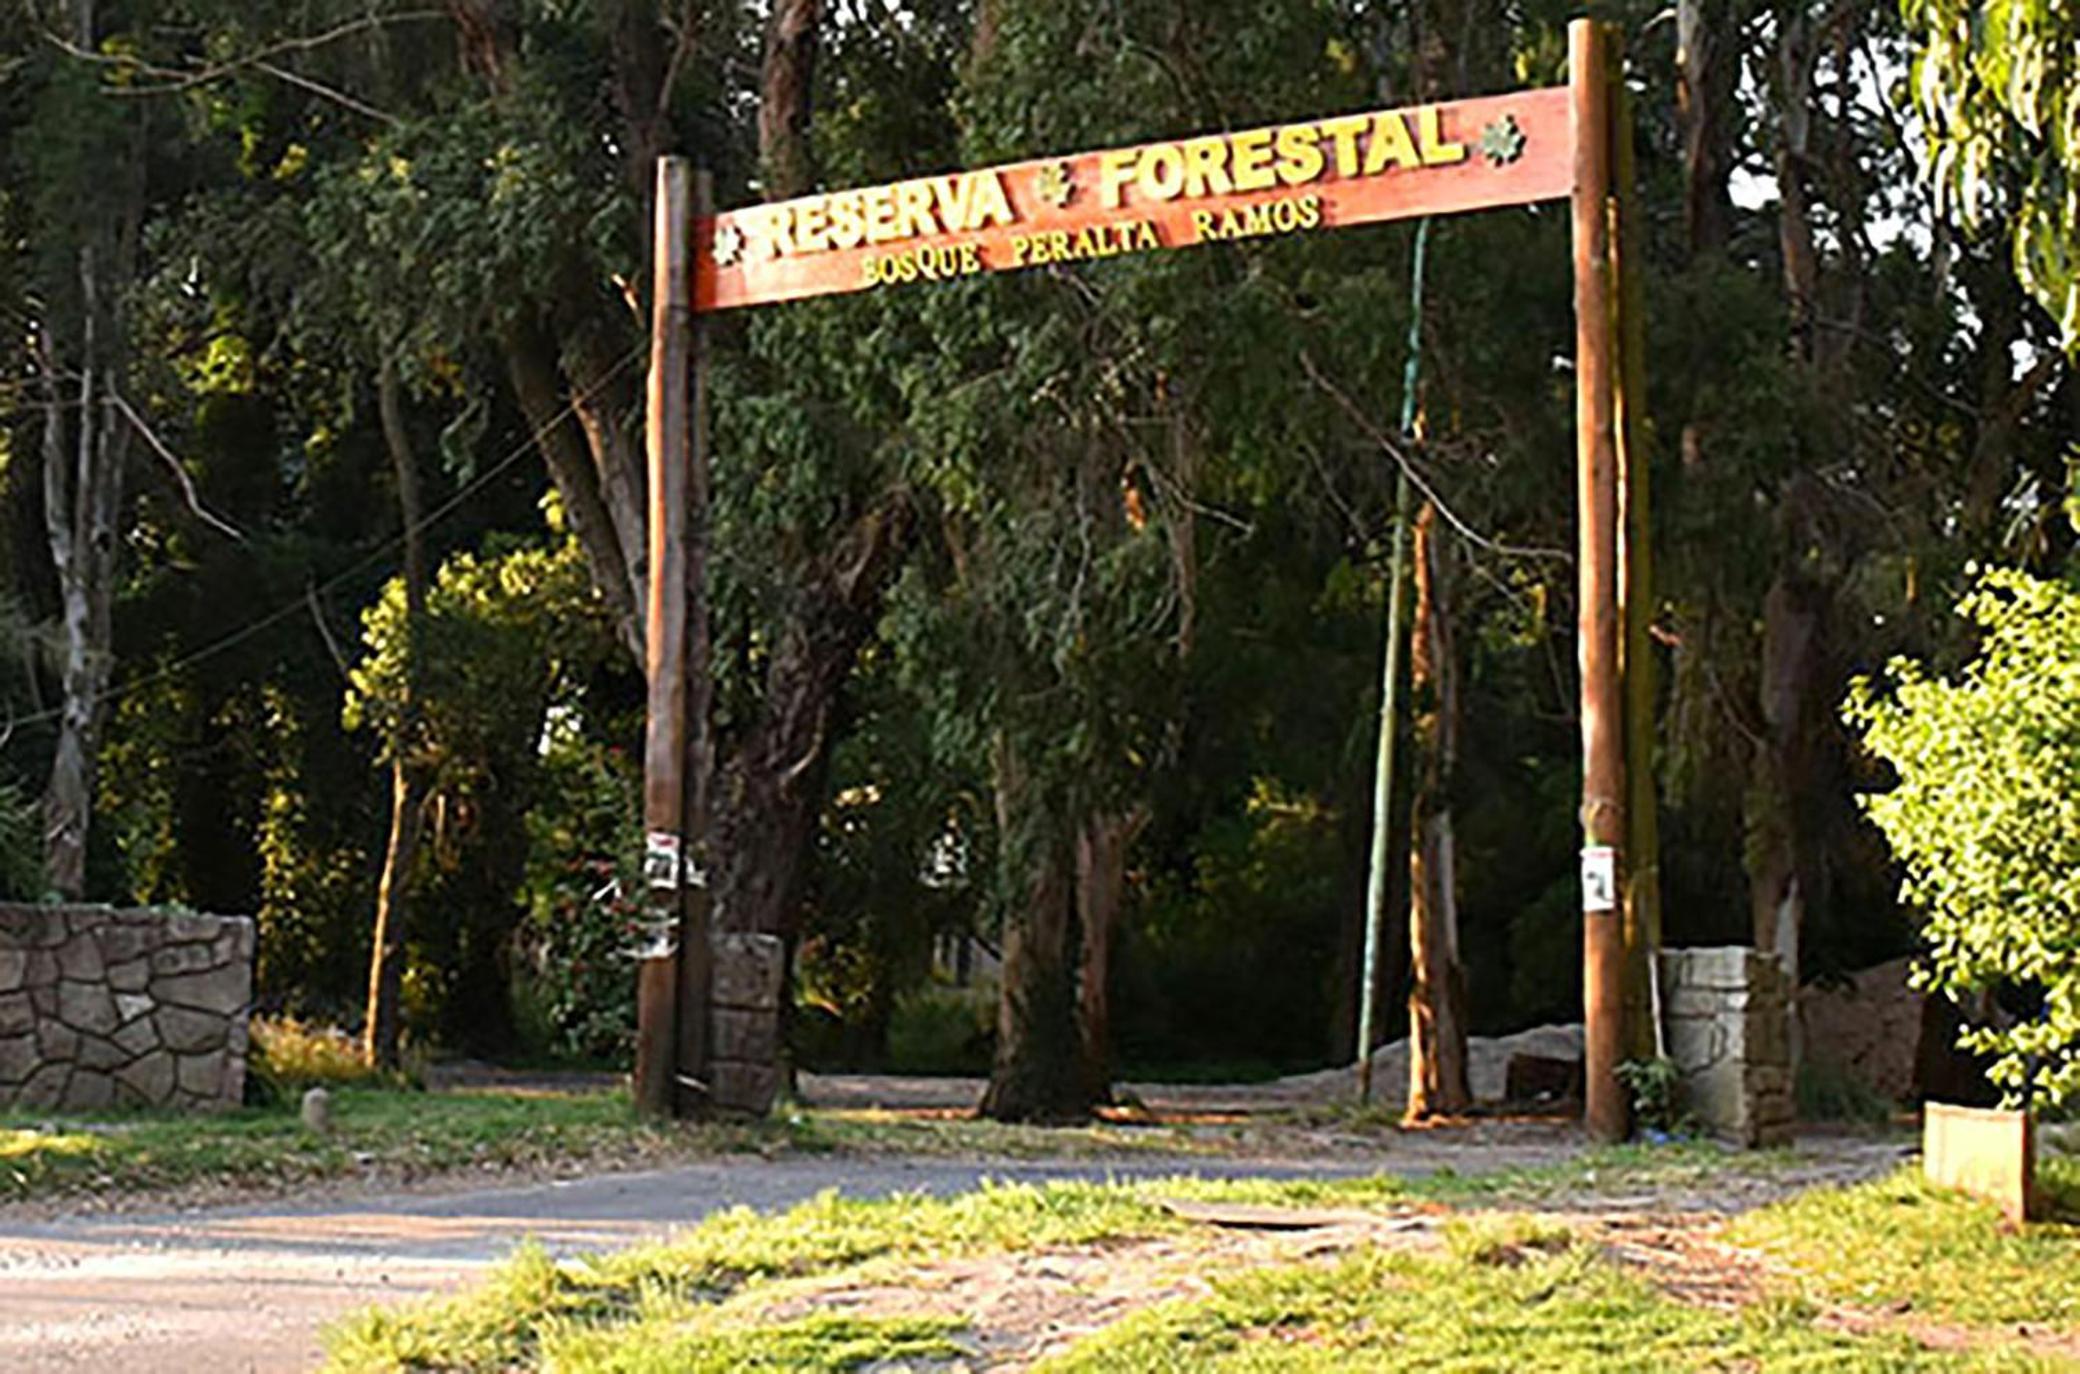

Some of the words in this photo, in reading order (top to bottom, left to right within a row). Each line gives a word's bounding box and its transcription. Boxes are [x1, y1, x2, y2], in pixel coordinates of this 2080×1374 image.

[758, 171, 1016, 258] RESERVA
[1099, 105, 1465, 208] FORESTAL
[862, 243, 981, 283] BOSQUE
[1013, 219, 1158, 265] PERALTA
[1191, 193, 1320, 243] RAMOS
